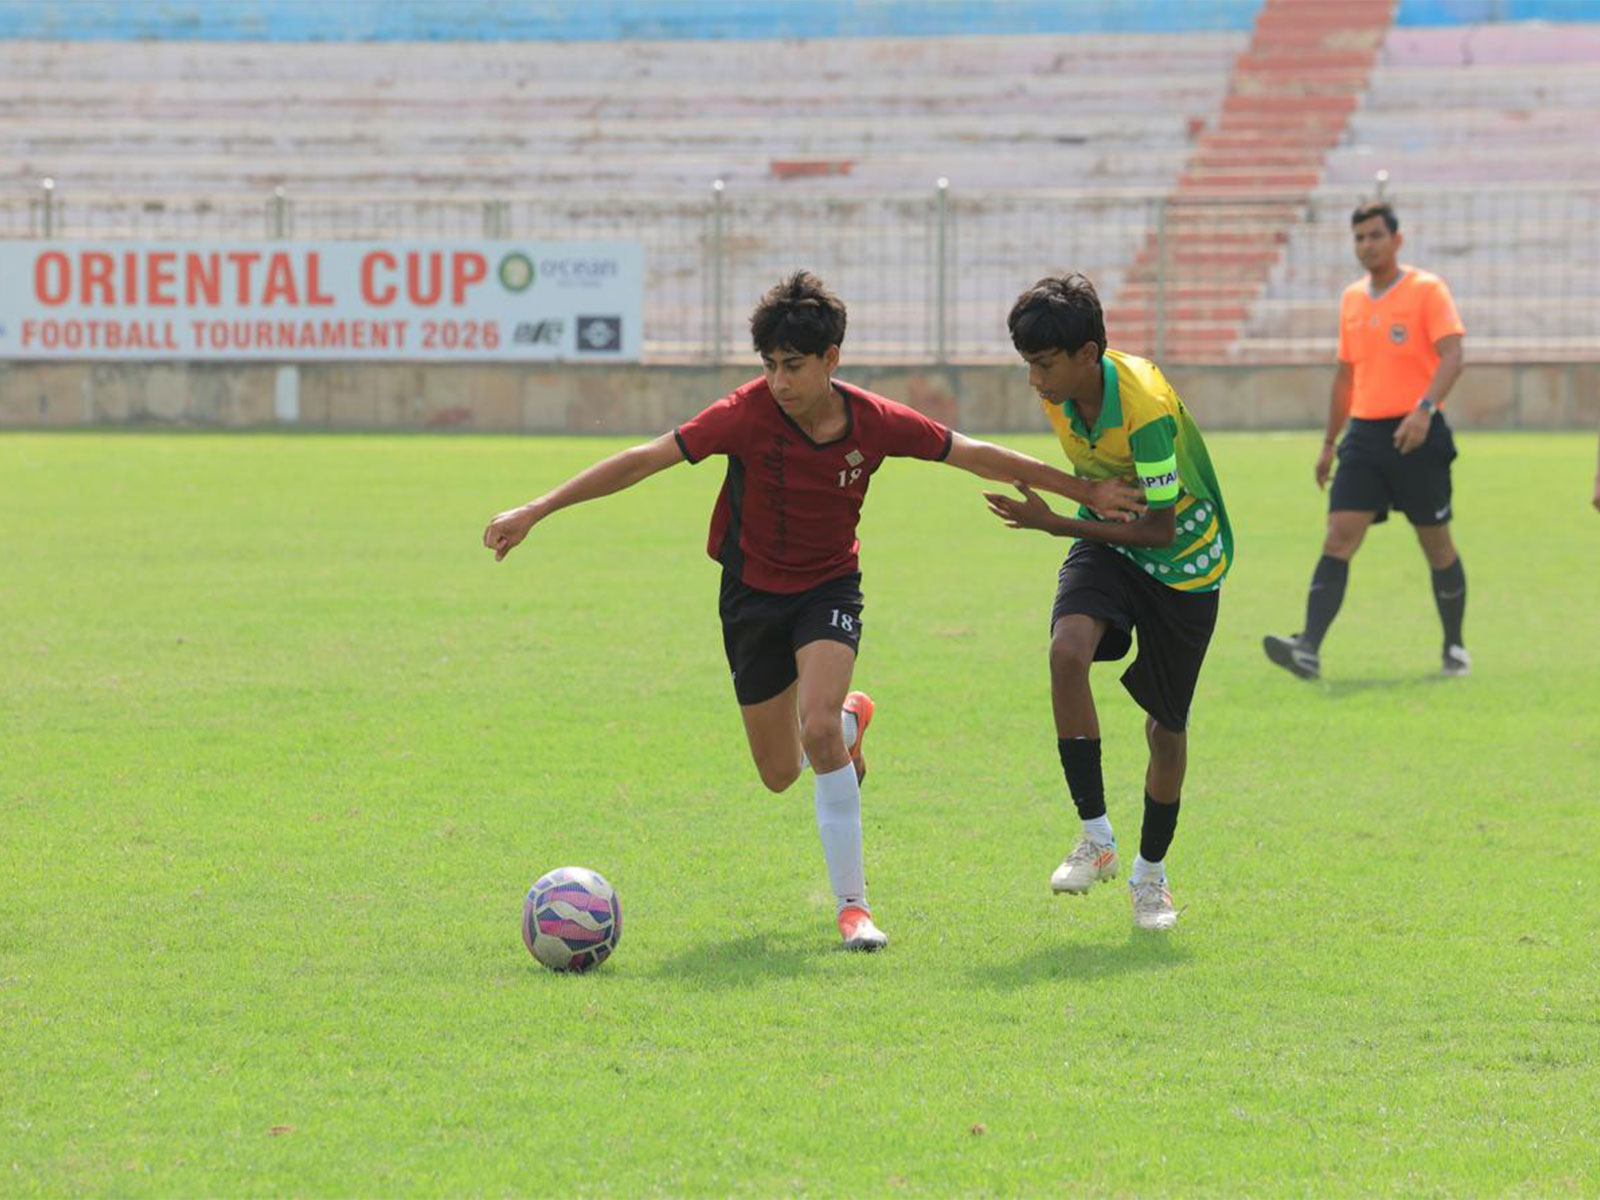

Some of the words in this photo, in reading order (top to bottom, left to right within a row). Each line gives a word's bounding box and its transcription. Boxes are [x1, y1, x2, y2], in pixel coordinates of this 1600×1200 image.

[34, 248, 335, 308] ORIENTAL
[360, 248, 489, 308] CUP
[20, 319, 179, 350] FOOTBALL
[191, 318, 408, 350] TOURNAMENT
[420, 318, 501, 350] 2026
[828, 609, 853, 632] 18
